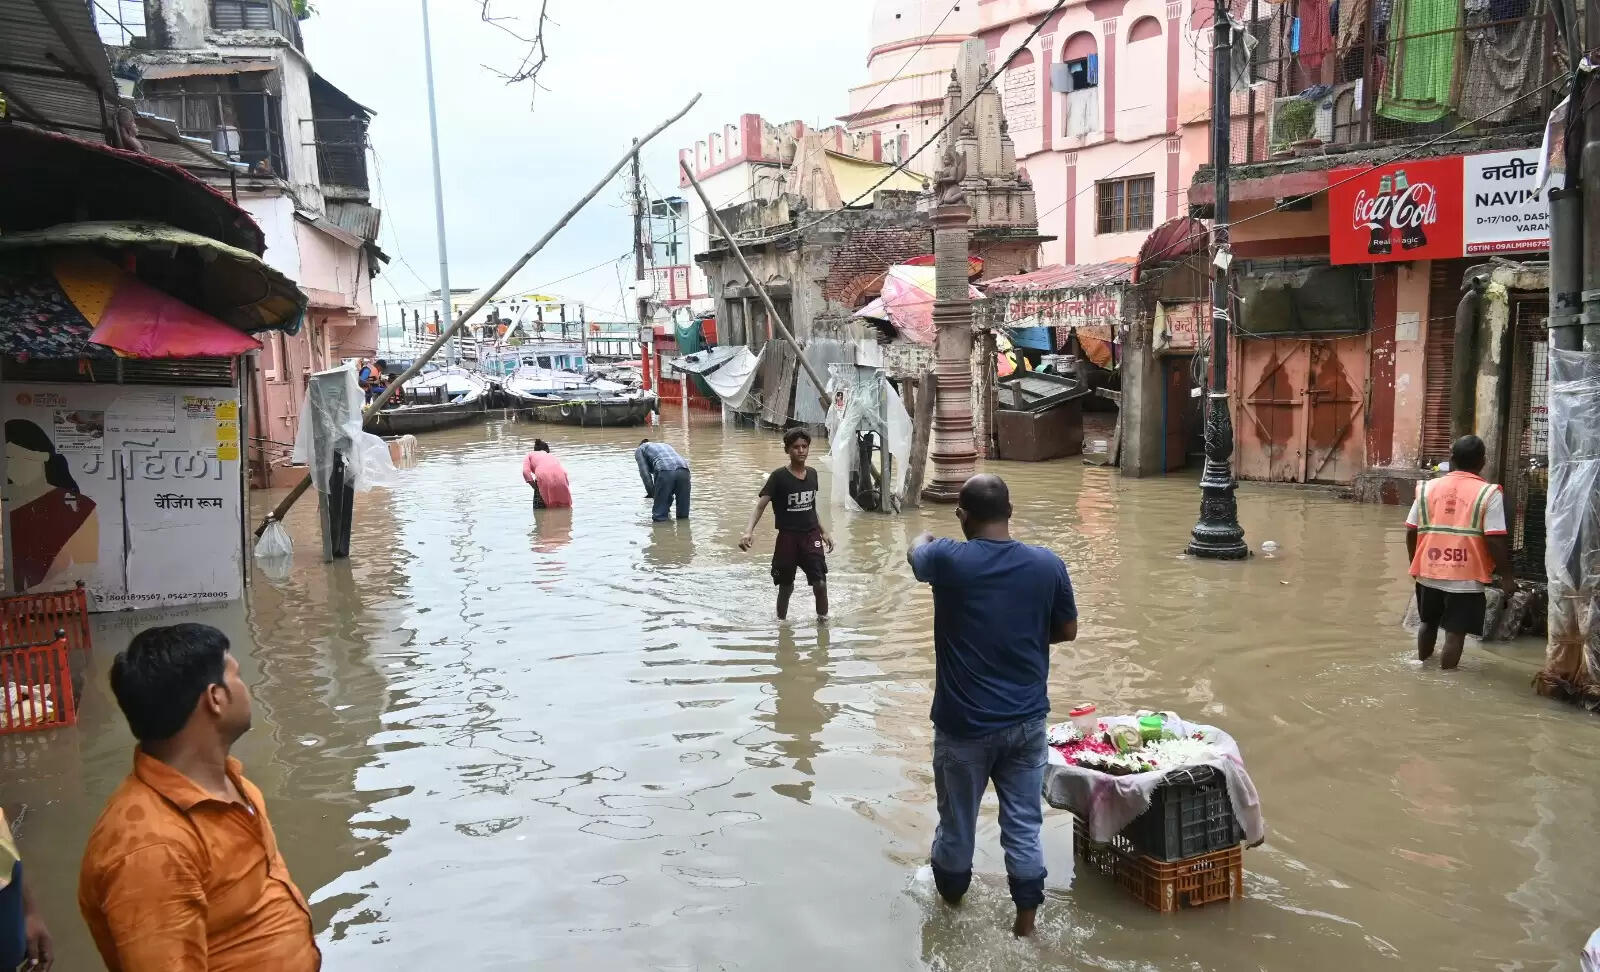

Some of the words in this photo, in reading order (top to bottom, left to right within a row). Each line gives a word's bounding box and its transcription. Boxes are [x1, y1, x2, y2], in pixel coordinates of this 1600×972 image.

[1475, 189, 1540, 207] NAVIN
[1353, 183, 1437, 230] Coca-Cola
[1476, 215, 1521, 224] D-17/100,
[1468, 244, 1490, 252] GSTIN
[196, 498, 223, 509] रूम
[1443, 548, 1468, 562] SBI
